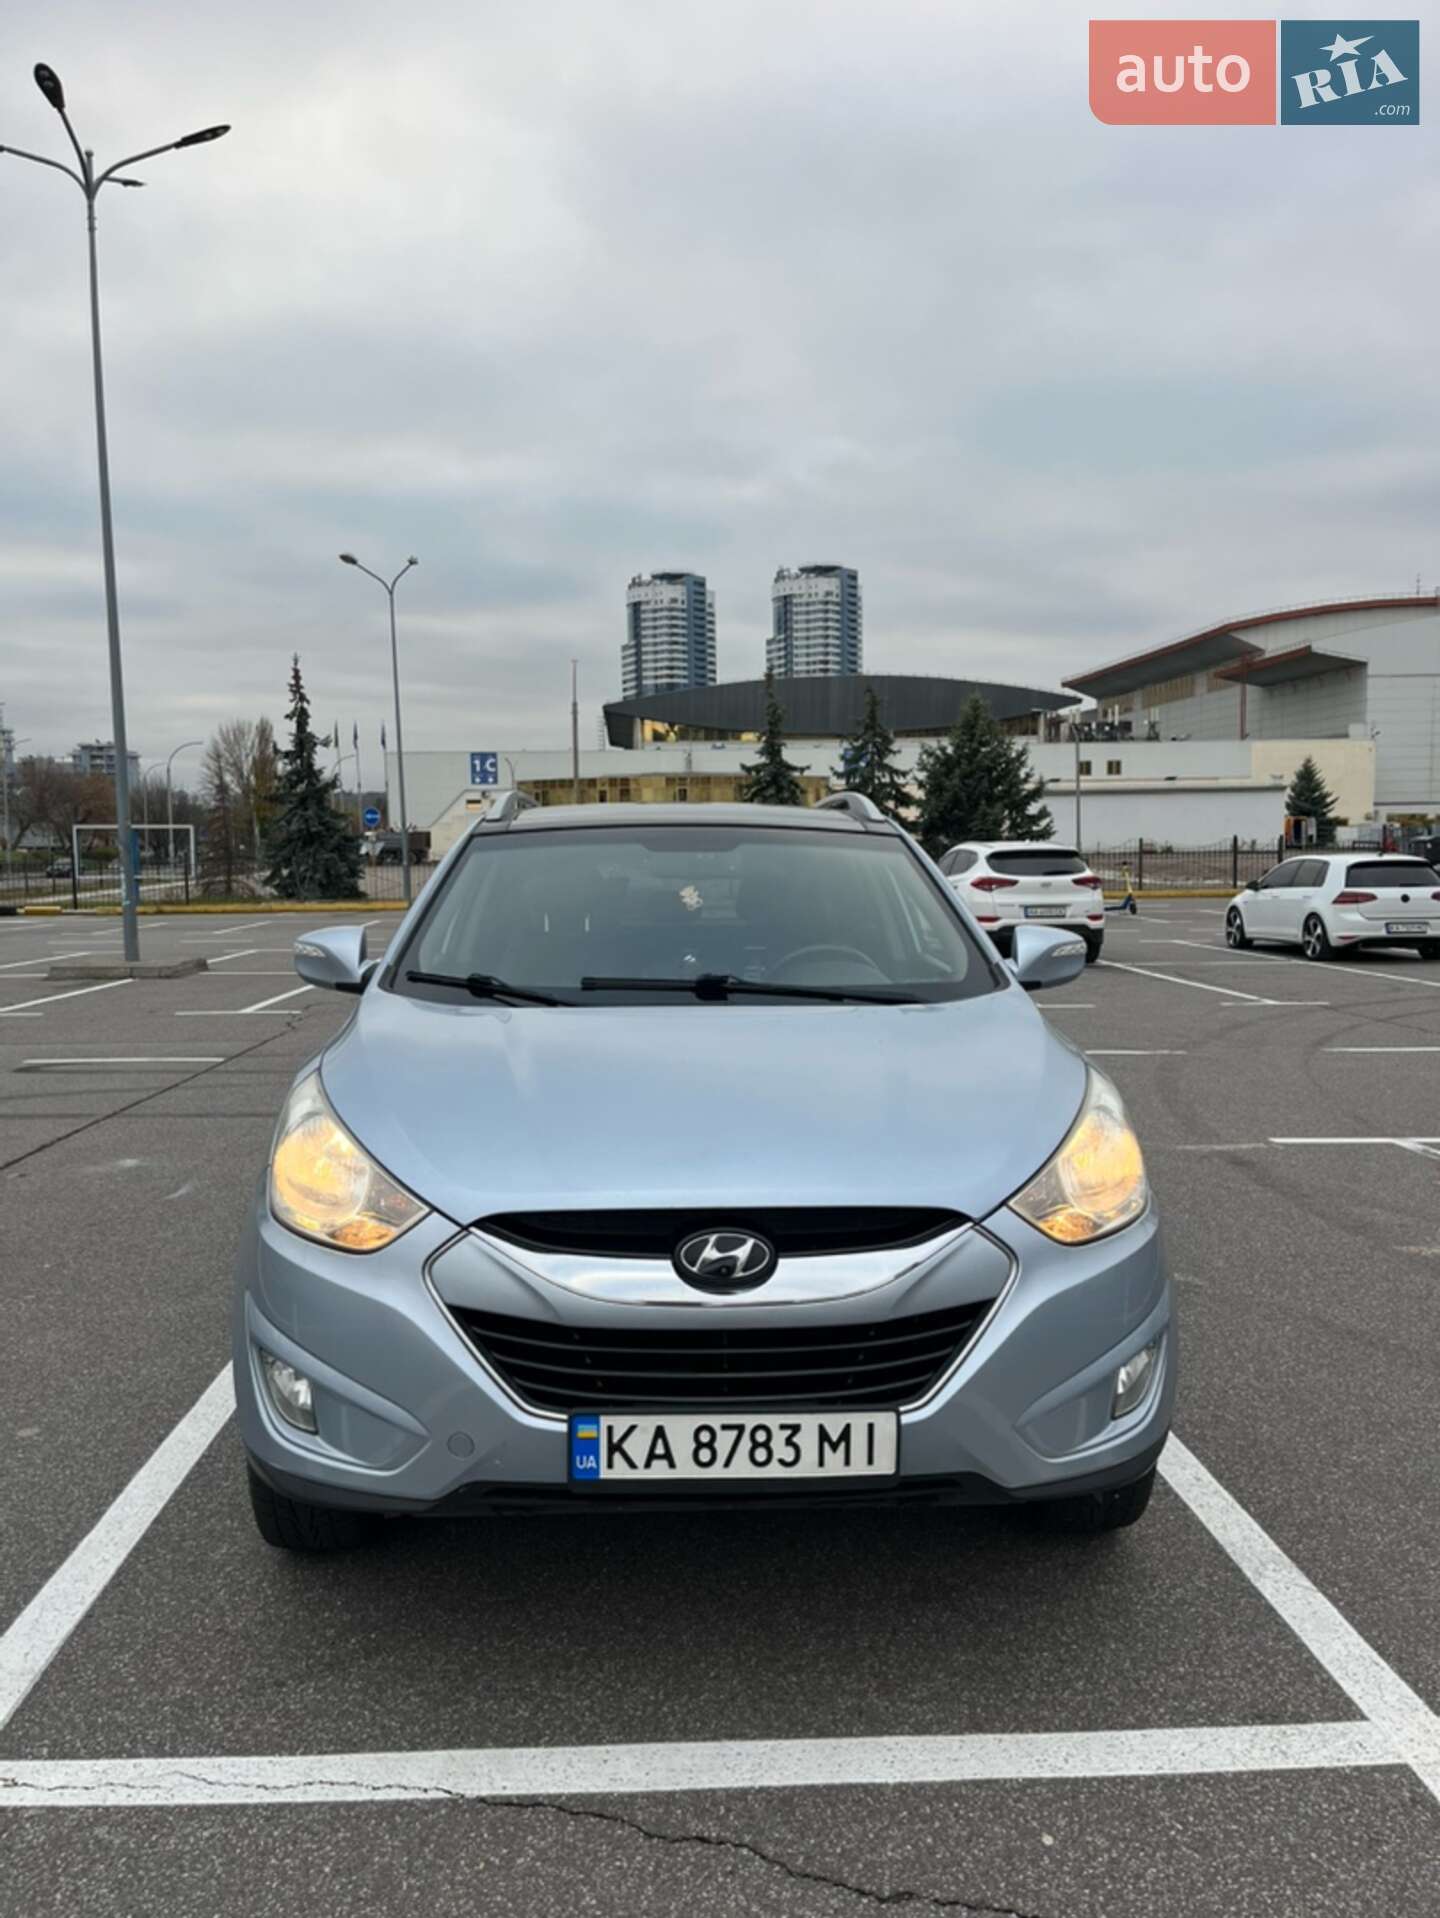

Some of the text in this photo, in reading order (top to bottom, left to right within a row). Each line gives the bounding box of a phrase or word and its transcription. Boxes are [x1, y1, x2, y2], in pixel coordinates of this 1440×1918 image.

[576, 1422, 875, 1470] UA KA 8783 MI
